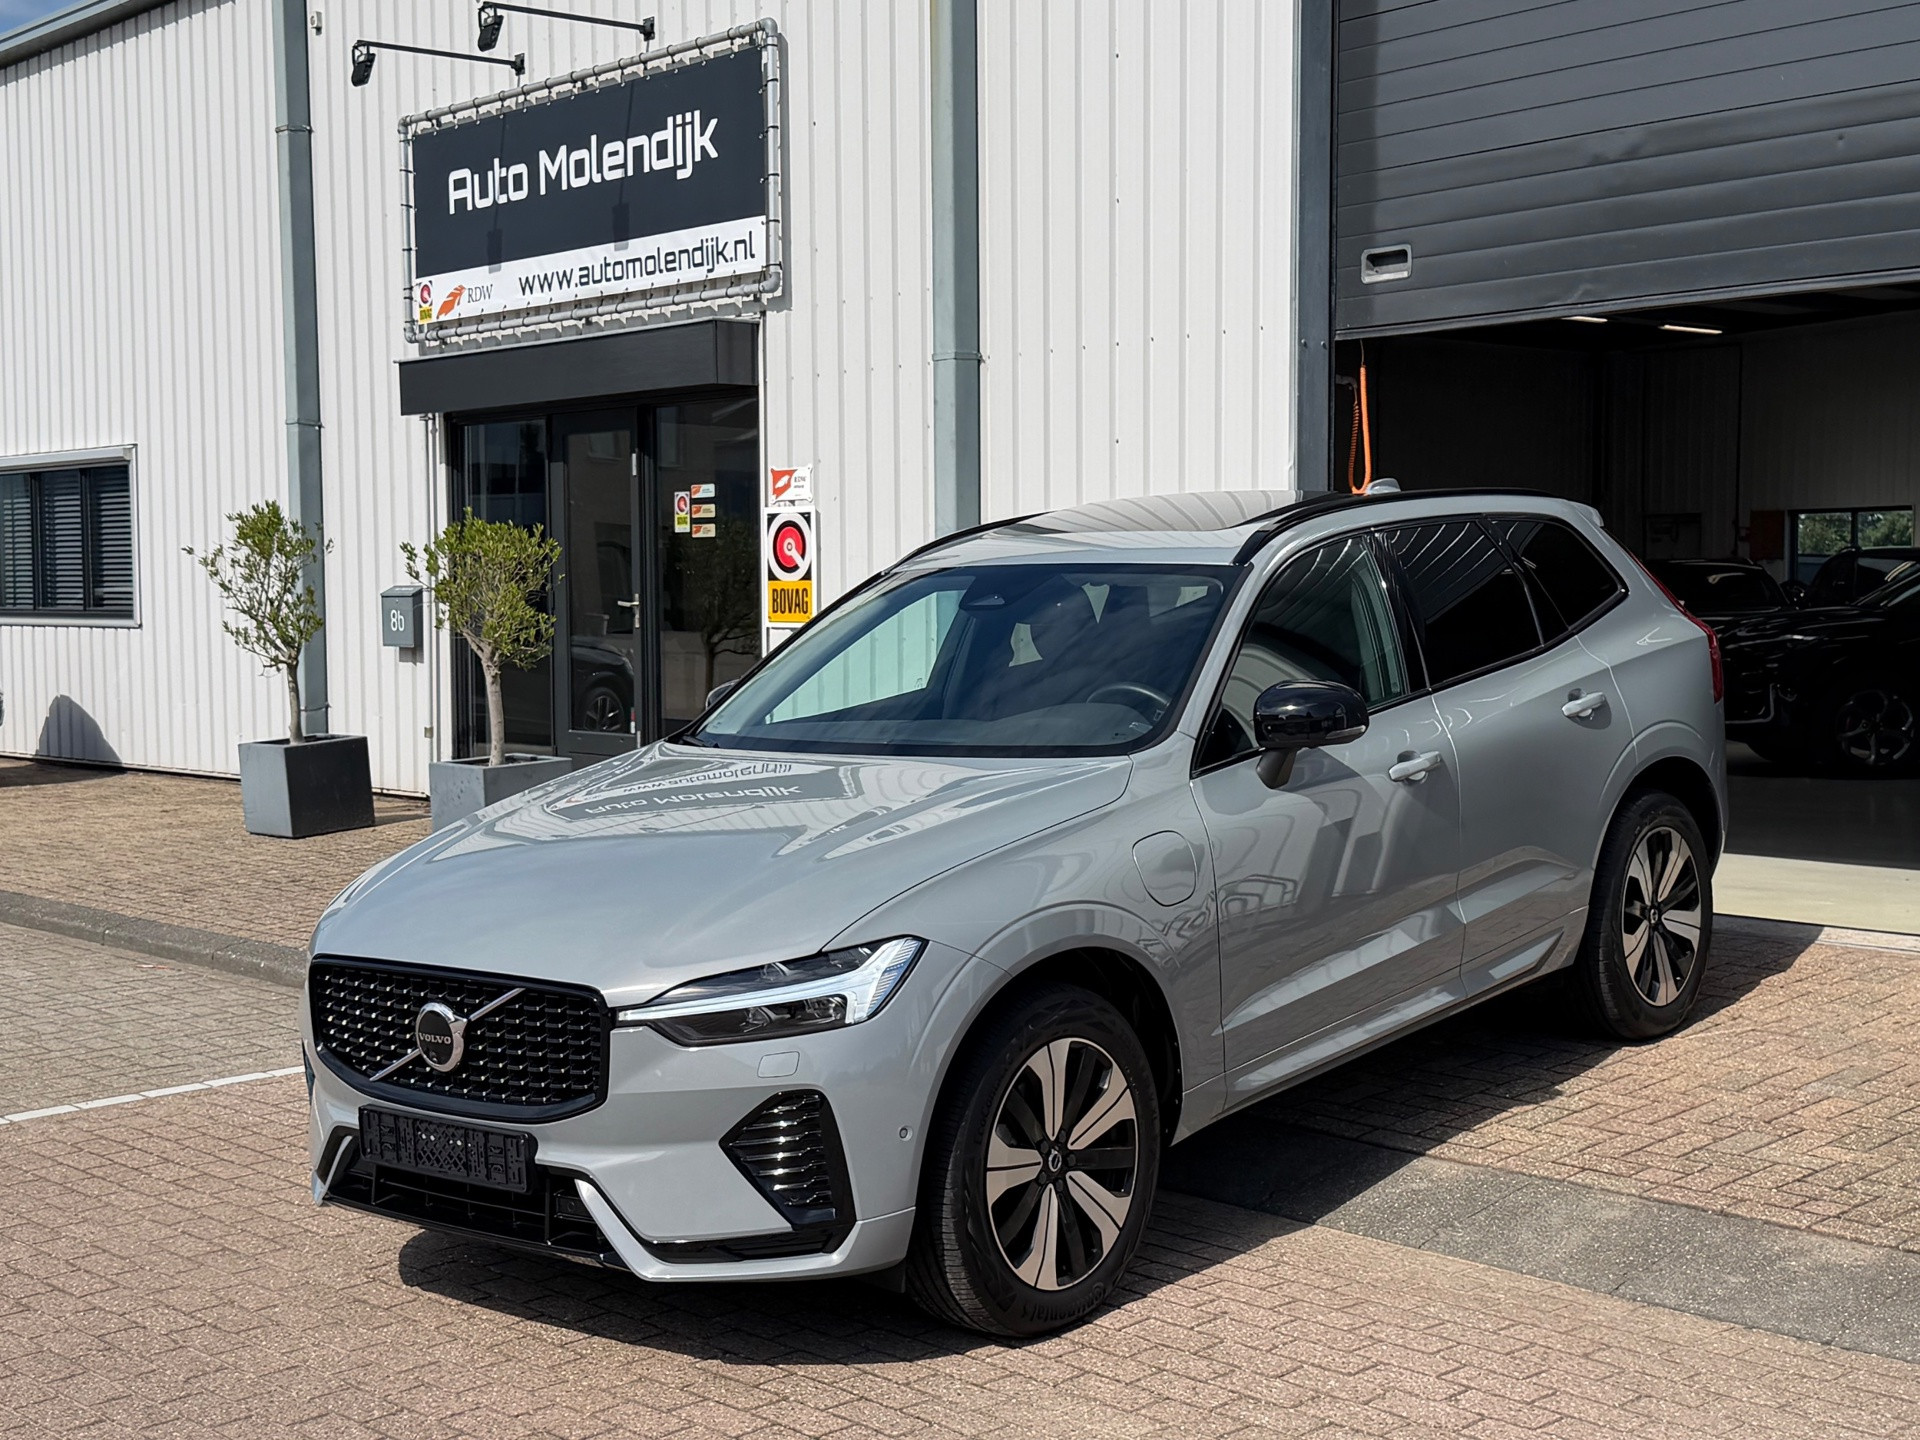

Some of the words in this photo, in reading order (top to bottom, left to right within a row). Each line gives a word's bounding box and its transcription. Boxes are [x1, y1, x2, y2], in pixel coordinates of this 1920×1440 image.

[448, 158, 528, 214] Auto
[538, 109, 719, 195] Molendijk
[518, 231, 755, 296] www.automolendijk.nl
[467, 284, 493, 303] RDW
[772, 587, 808, 614] BOVAG
[390, 609, 405, 631] 8b
[418, 1032, 452, 1045] VOLVO
